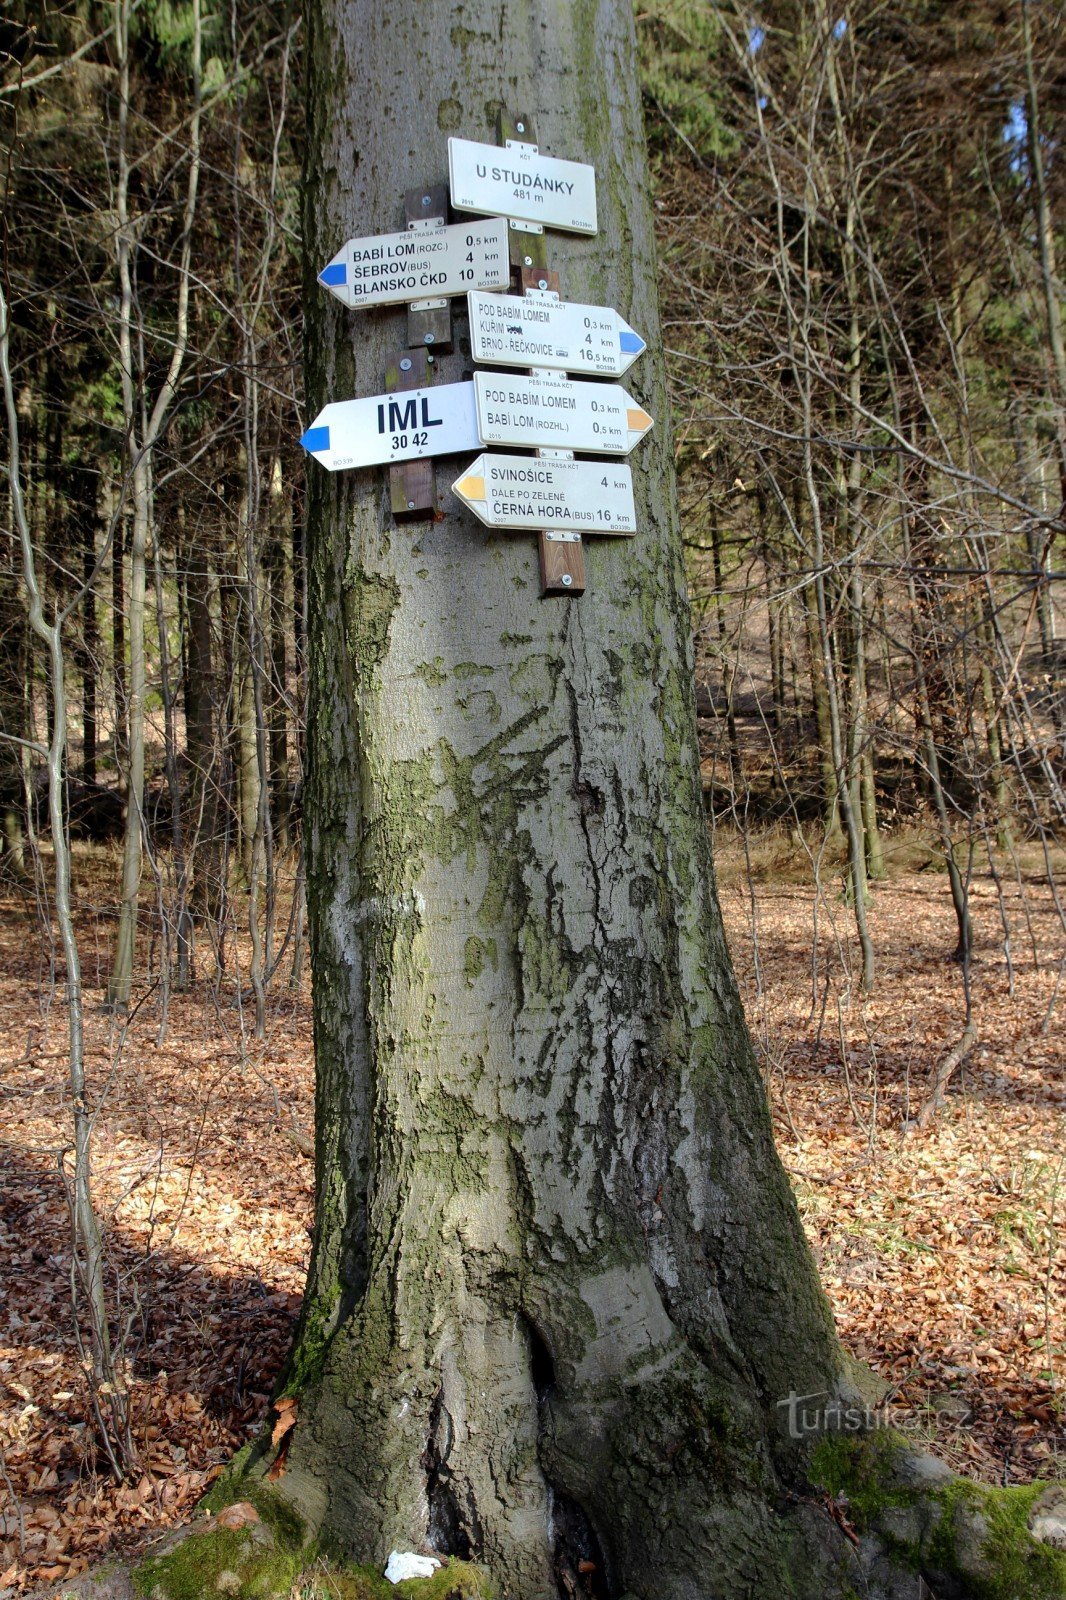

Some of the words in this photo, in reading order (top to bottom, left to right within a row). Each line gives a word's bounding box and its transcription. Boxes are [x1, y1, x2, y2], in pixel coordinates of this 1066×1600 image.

[476, 164, 487, 178] U
[492, 167, 574, 196] STUDÁNKY
[513, 188, 530, 200] 481
[534, 194, 544, 202] m
[435, 228, 447, 236] KČT
[466, 235, 481, 247] 0,5
[484, 236, 498, 244] km
[353, 245, 384, 262] BABÍ
[466, 252, 474, 263] 4
[484, 252, 498, 261] km
[459, 268, 474, 281] 10
[485, 269, 499, 278] km
[354, 276, 416, 295] BLANSKO
[420, 270, 447, 286] ČKD
[536, 300, 554, 308] TRASA
[479, 304, 494, 316] POD
[497, 306, 521, 319] BABÍM
[523, 310, 550, 323] LOMEM
[480, 319, 504, 334] KUŘIM
[584, 317, 598, 329] 0,3
[600, 322, 612, 330] km
[481, 337, 503, 350] BRNO
[510, 338, 552, 356] ŘEČKOVICE
[585, 334, 592, 344] 4
[601, 338, 613, 347] km
[580, 349, 600, 362] 16,5
[602, 354, 615, 363] km
[485, 390, 506, 402] POD
[509, 392, 539, 406] BABÍM
[542, 396, 576, 409] LOMEM
[591, 401, 605, 412] 0,3
[607, 405, 620, 414] km
[378, 398, 443, 434] IML
[487, 413, 510, 426] BABÍ
[592, 422, 607, 434] 0,5
[609, 427, 622, 435] km
[392, 434, 407, 450] 30
[412, 432, 428, 447] 42
[491, 468, 553, 484] SVINOŠICE
[600, 476, 608, 488] 4
[613, 481, 627, 489] km
[532, 492, 566, 501] ZELENÉ
[493, 500, 535, 516] ČERNÁ
[597, 510, 611, 521] 16
[617, 514, 630, 523] km
